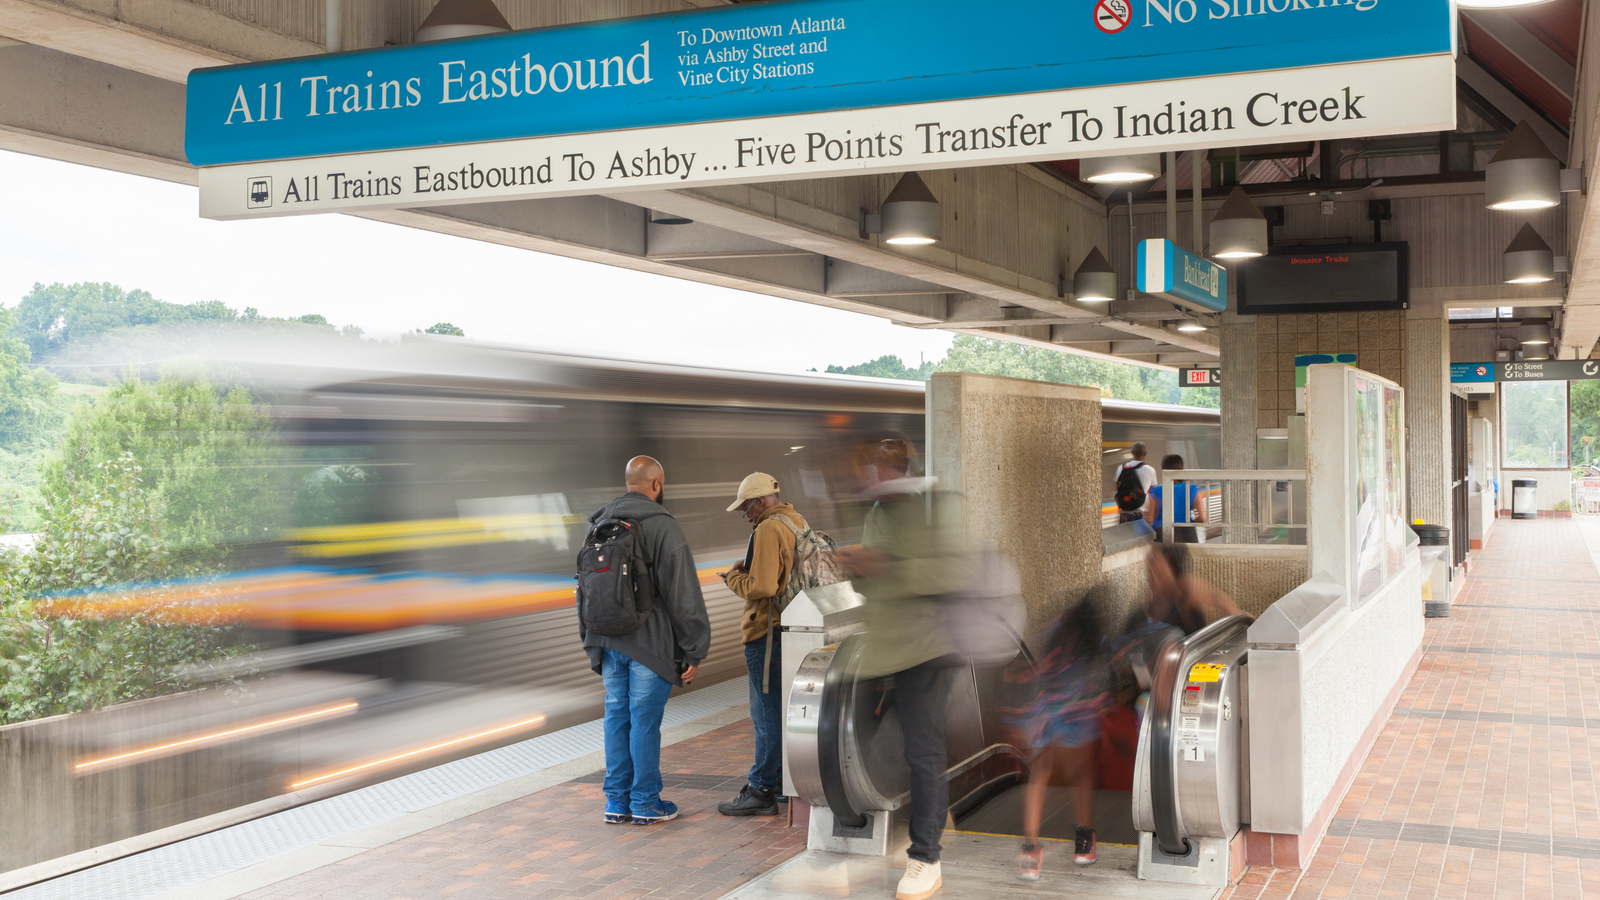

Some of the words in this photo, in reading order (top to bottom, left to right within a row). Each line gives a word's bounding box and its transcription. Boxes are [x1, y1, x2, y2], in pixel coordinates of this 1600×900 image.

[1143, 0, 1198, 27] No
[677, 30, 697, 47] To
[701, 27, 783, 45] Downtown
[788, 16, 847, 35] Atlanta
[677, 51, 699, 66] via
[703, 46, 750, 65] Ashby
[752, 43, 796, 60] Street
[799, 36, 828, 56] and
[223, 81, 284, 125] All
[299, 70, 422, 118] Trains
[437, 40, 654, 105] Eastbound
[677, 69, 714, 87] Vine
[716, 65, 751, 85] City
[752, 59, 815, 80] Stations
[282, 175, 320, 204] All
[326, 170, 402, 200] Trains
[413, 156, 553, 194] Eastbound
[562, 152, 595, 182] To
[605, 146, 697, 180] Ashby
[736, 137, 796, 168] Five
[806, 129, 903, 163] Points
[915, 113, 1052, 154] Transfer
[1060, 109, 1103, 143] To
[1113, 100, 1236, 139] Indian
[1246, 86, 1367, 127] Creek
[1184, 254, 1210, 292] Bankhead
[1291, 257, 1322, 265] Upcoming
[1191, 371, 1207, 383] EXIT
[801, 705, 807, 719] 1
[1191, 746, 1198, 761] 1
